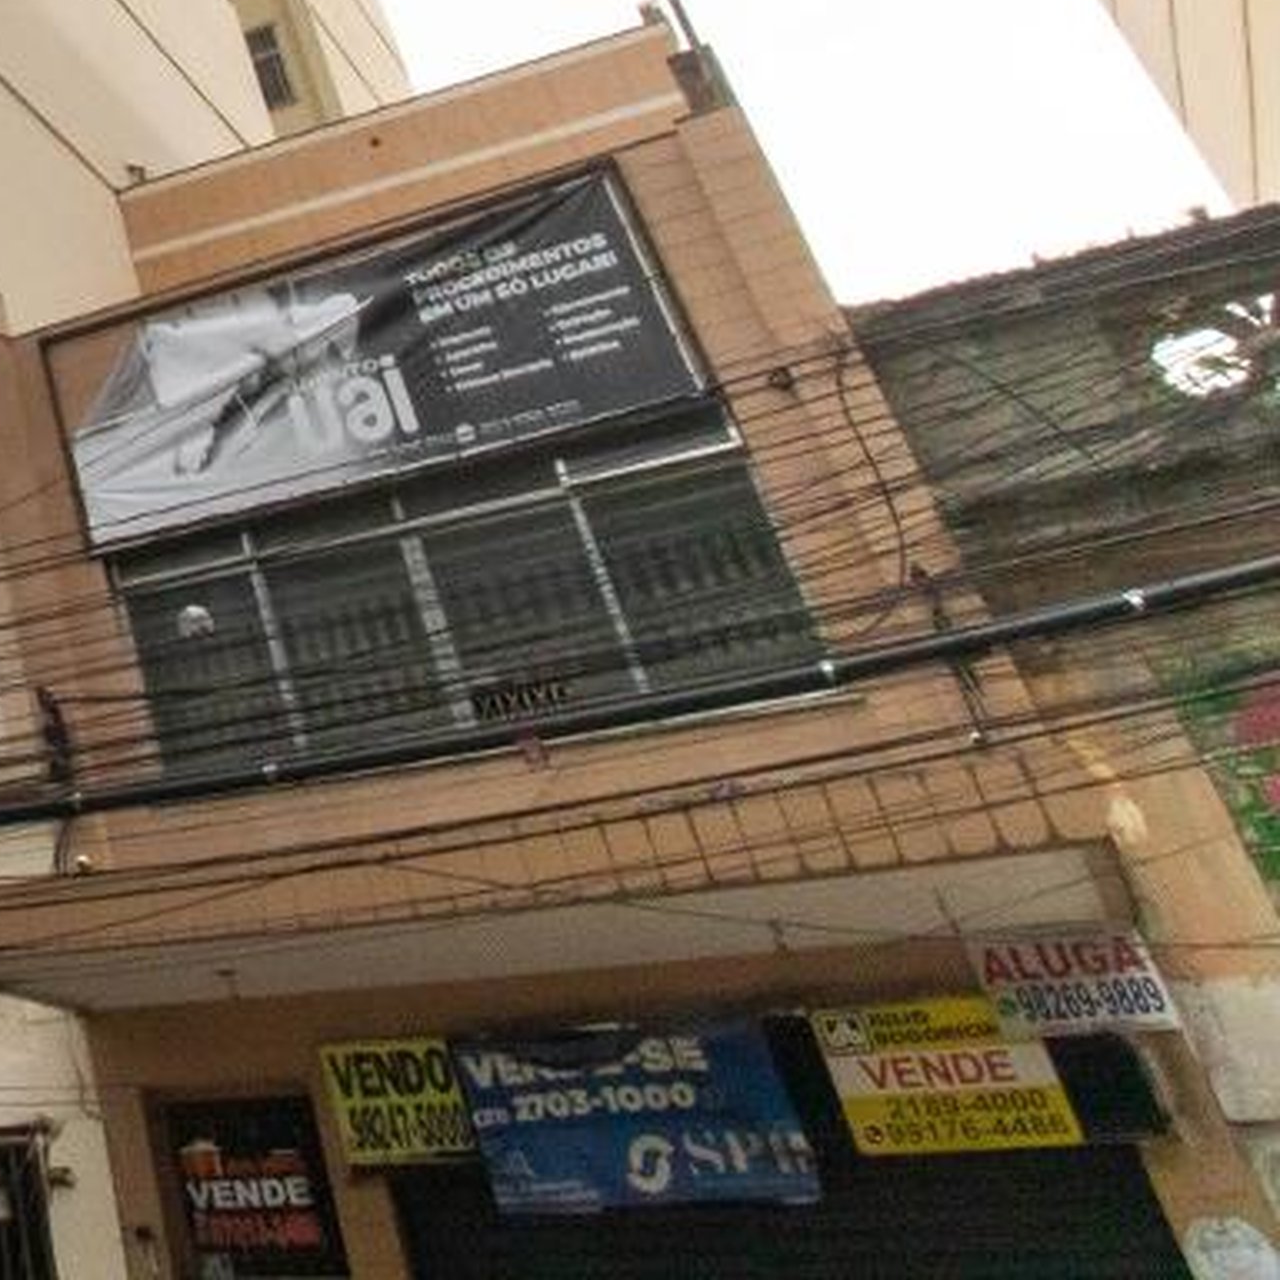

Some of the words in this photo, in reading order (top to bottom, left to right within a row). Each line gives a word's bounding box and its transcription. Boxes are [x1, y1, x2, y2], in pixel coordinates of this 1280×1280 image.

[983, 935, 1140, 985] ALUGA
[329, 1046, 455, 1098] VENDO
[859, 1050, 1016, 1090] VENDE
[511, 1082, 696, 1122] 2703-1000
[186, 1175, 314, 1210] VENDE
